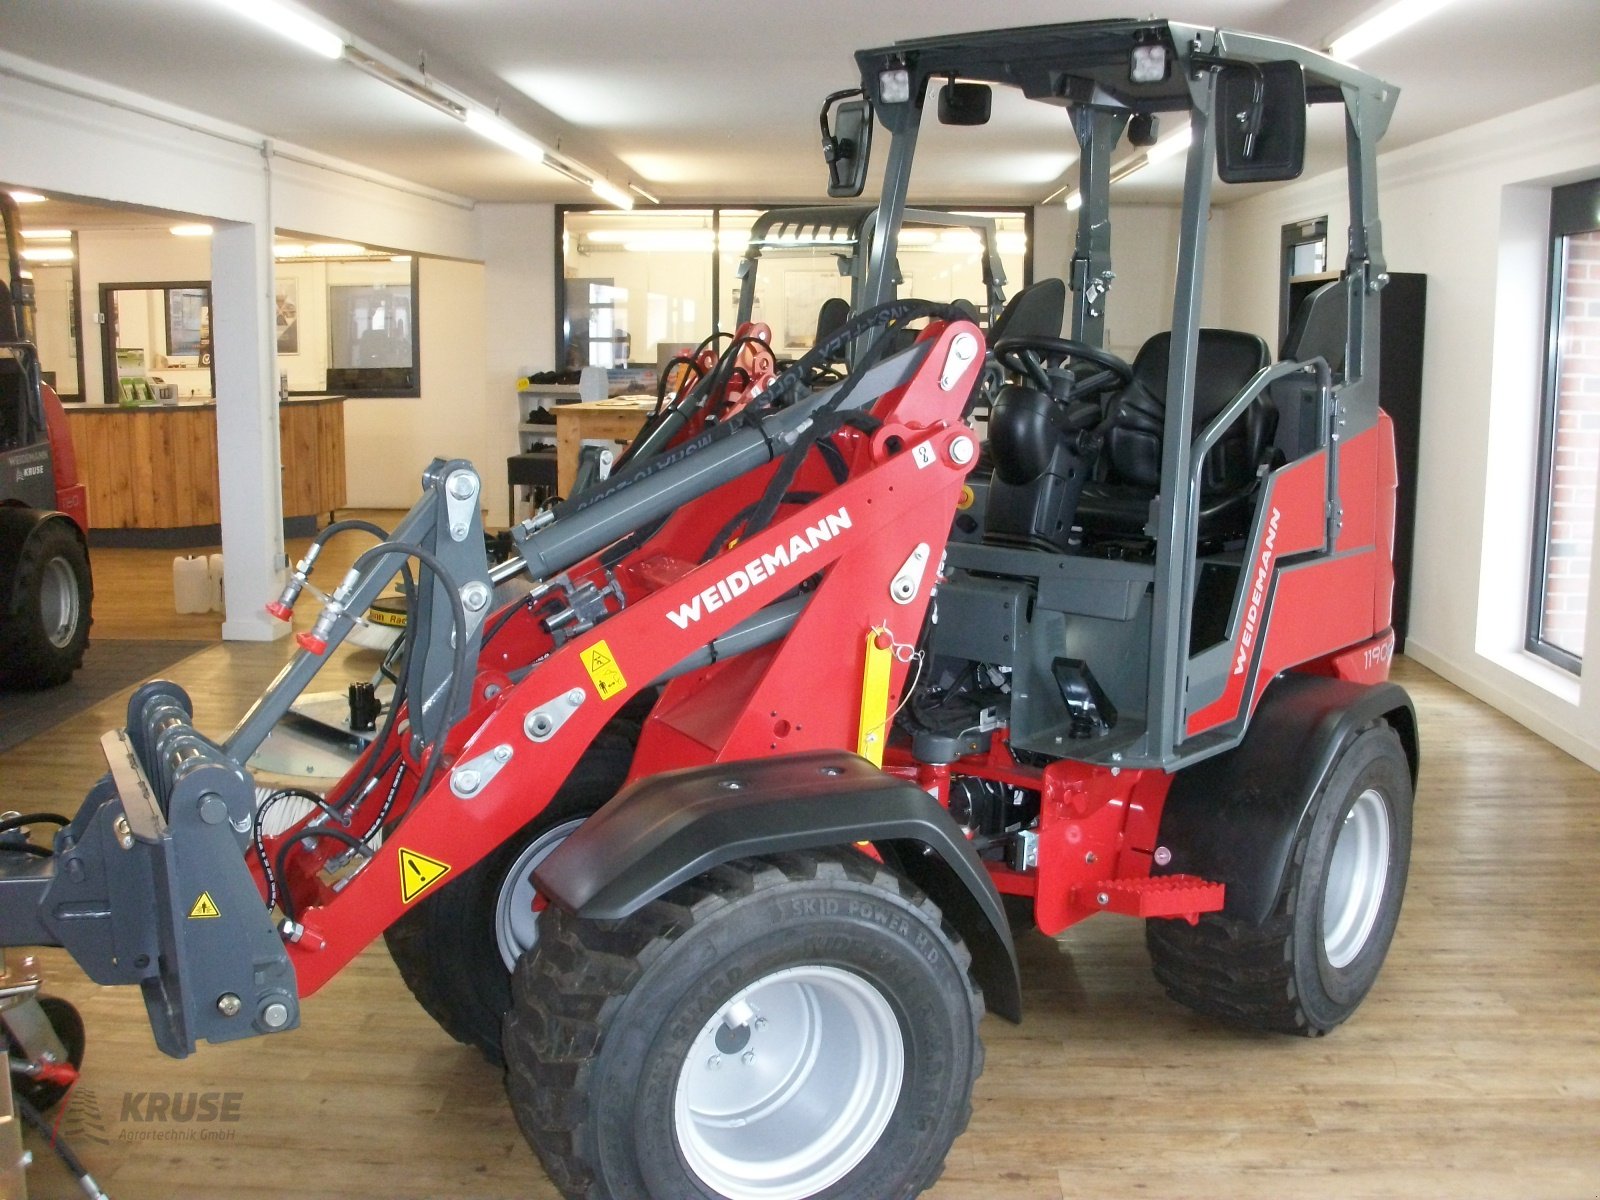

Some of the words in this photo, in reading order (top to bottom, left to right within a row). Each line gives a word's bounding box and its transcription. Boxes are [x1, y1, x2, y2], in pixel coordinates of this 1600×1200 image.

[23, 465, 44, 476] KRUSE
[665, 506, 853, 630] WEIDEMANN
[1233, 506, 1281, 675] WEIDEMANN
[791, 898, 839, 916] SKID
[849, 900, 910, 935] POWER
